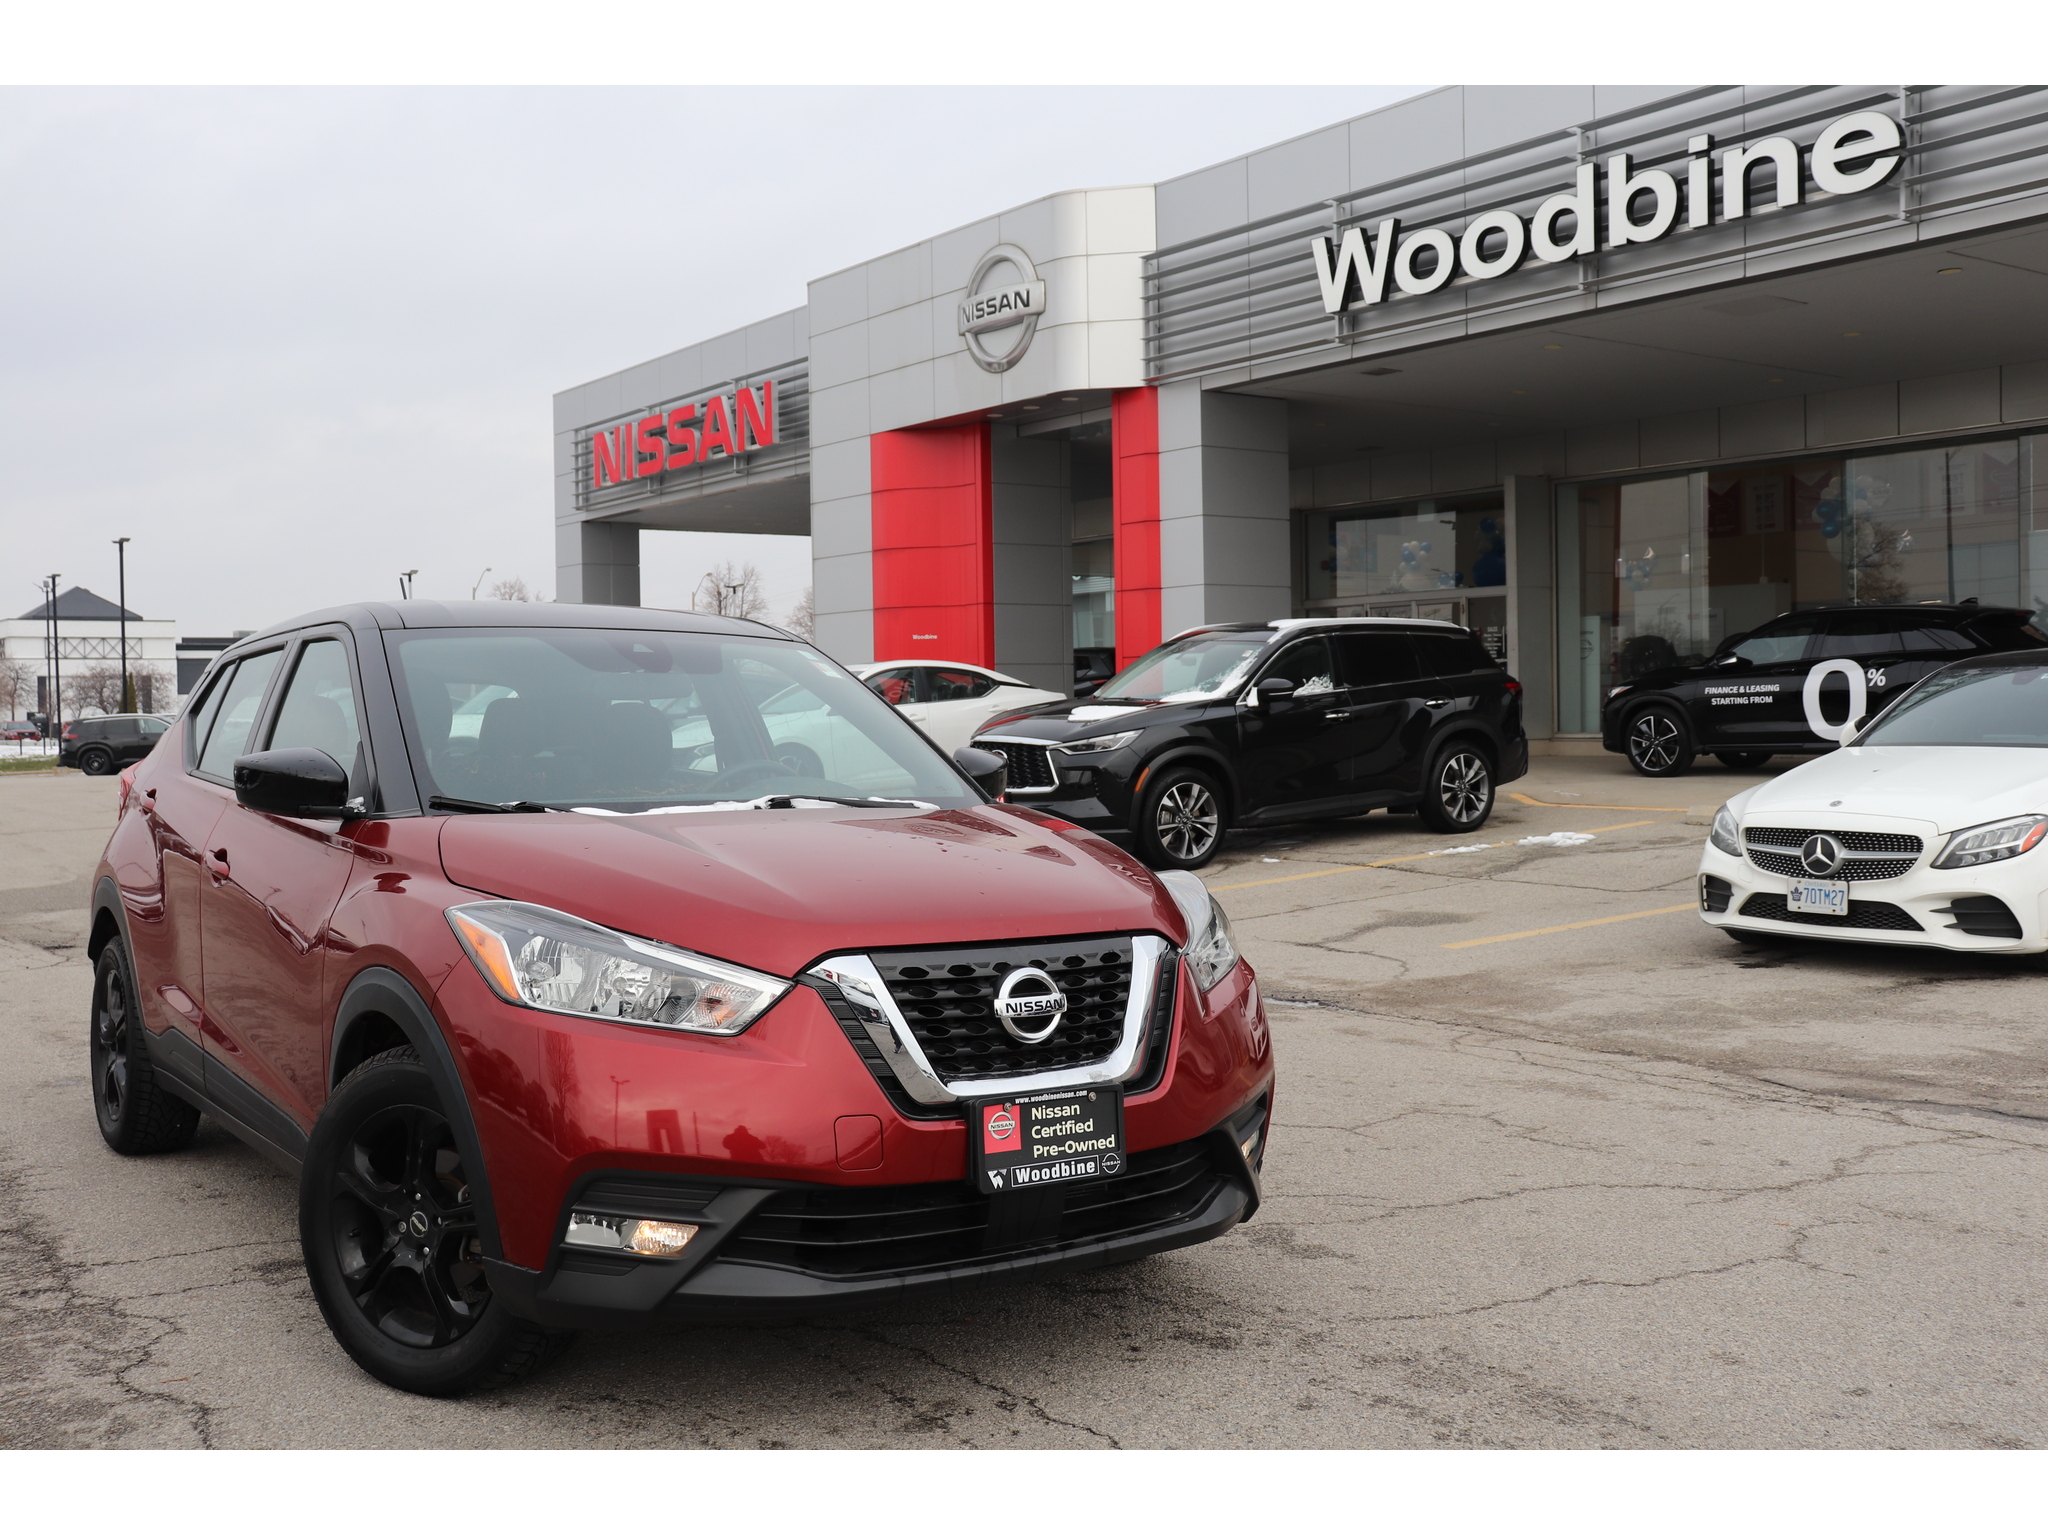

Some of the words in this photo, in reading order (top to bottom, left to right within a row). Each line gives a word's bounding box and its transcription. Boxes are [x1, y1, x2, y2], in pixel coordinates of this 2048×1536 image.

[1310, 110, 1905, 314] Woodbine
[961, 288, 1030, 325] NISSAN
[593, 380, 777, 488] NISSAN
[1704, 686, 1738, 695] FINANCE
[1739, 685, 1745, 693] &
[1746, 684, 1780, 693] LEASING
[1711, 697, 1749, 705] STARTING
[1749, 695, 1773, 704] FROM
[1005, 998, 1063, 1014] NISSAN
[1014, 1090, 1088, 1104] www.woodbinenissan.com
[1031, 1104, 1080, 1121] Nissan
[990, 1121, 1014, 1130] NISSAN
[1031, 1118, 1094, 1139] Certified
[1033, 1134, 1115, 1158] Pre-Owned
[1015, 1160, 1096, 1184] Woodbine
